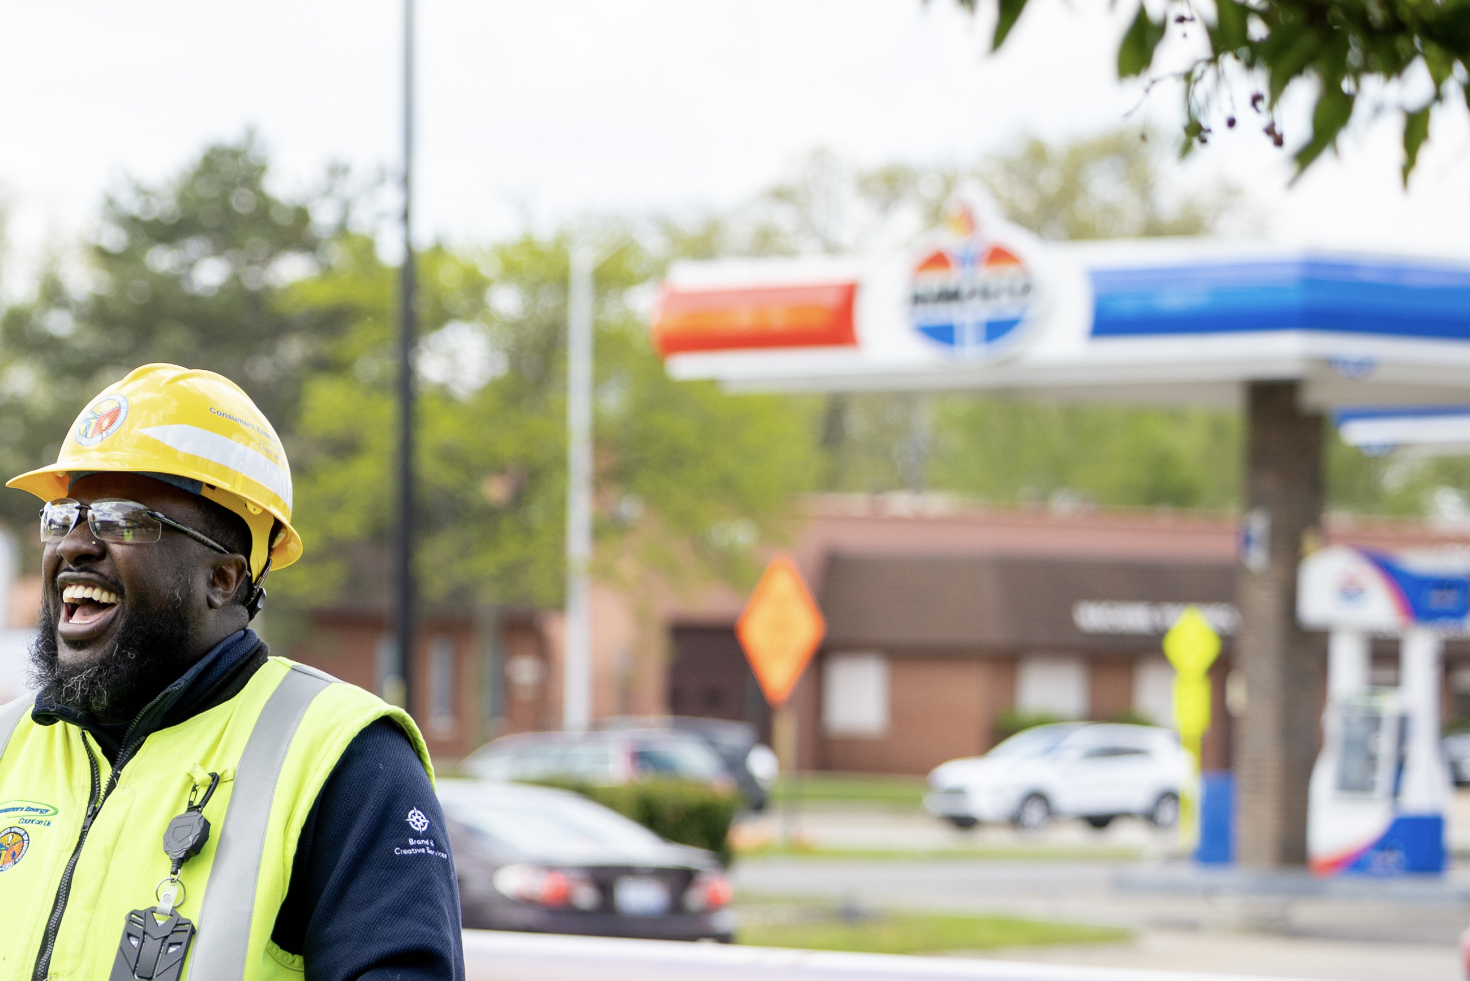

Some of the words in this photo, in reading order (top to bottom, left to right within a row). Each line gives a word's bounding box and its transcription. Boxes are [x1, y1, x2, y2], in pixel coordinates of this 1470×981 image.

[209, 406, 255, 430] Consumers
[25, 806, 51, 815] Energy
[408, 837, 429, 846] Brand
[394, 847, 425, 855] Creative
